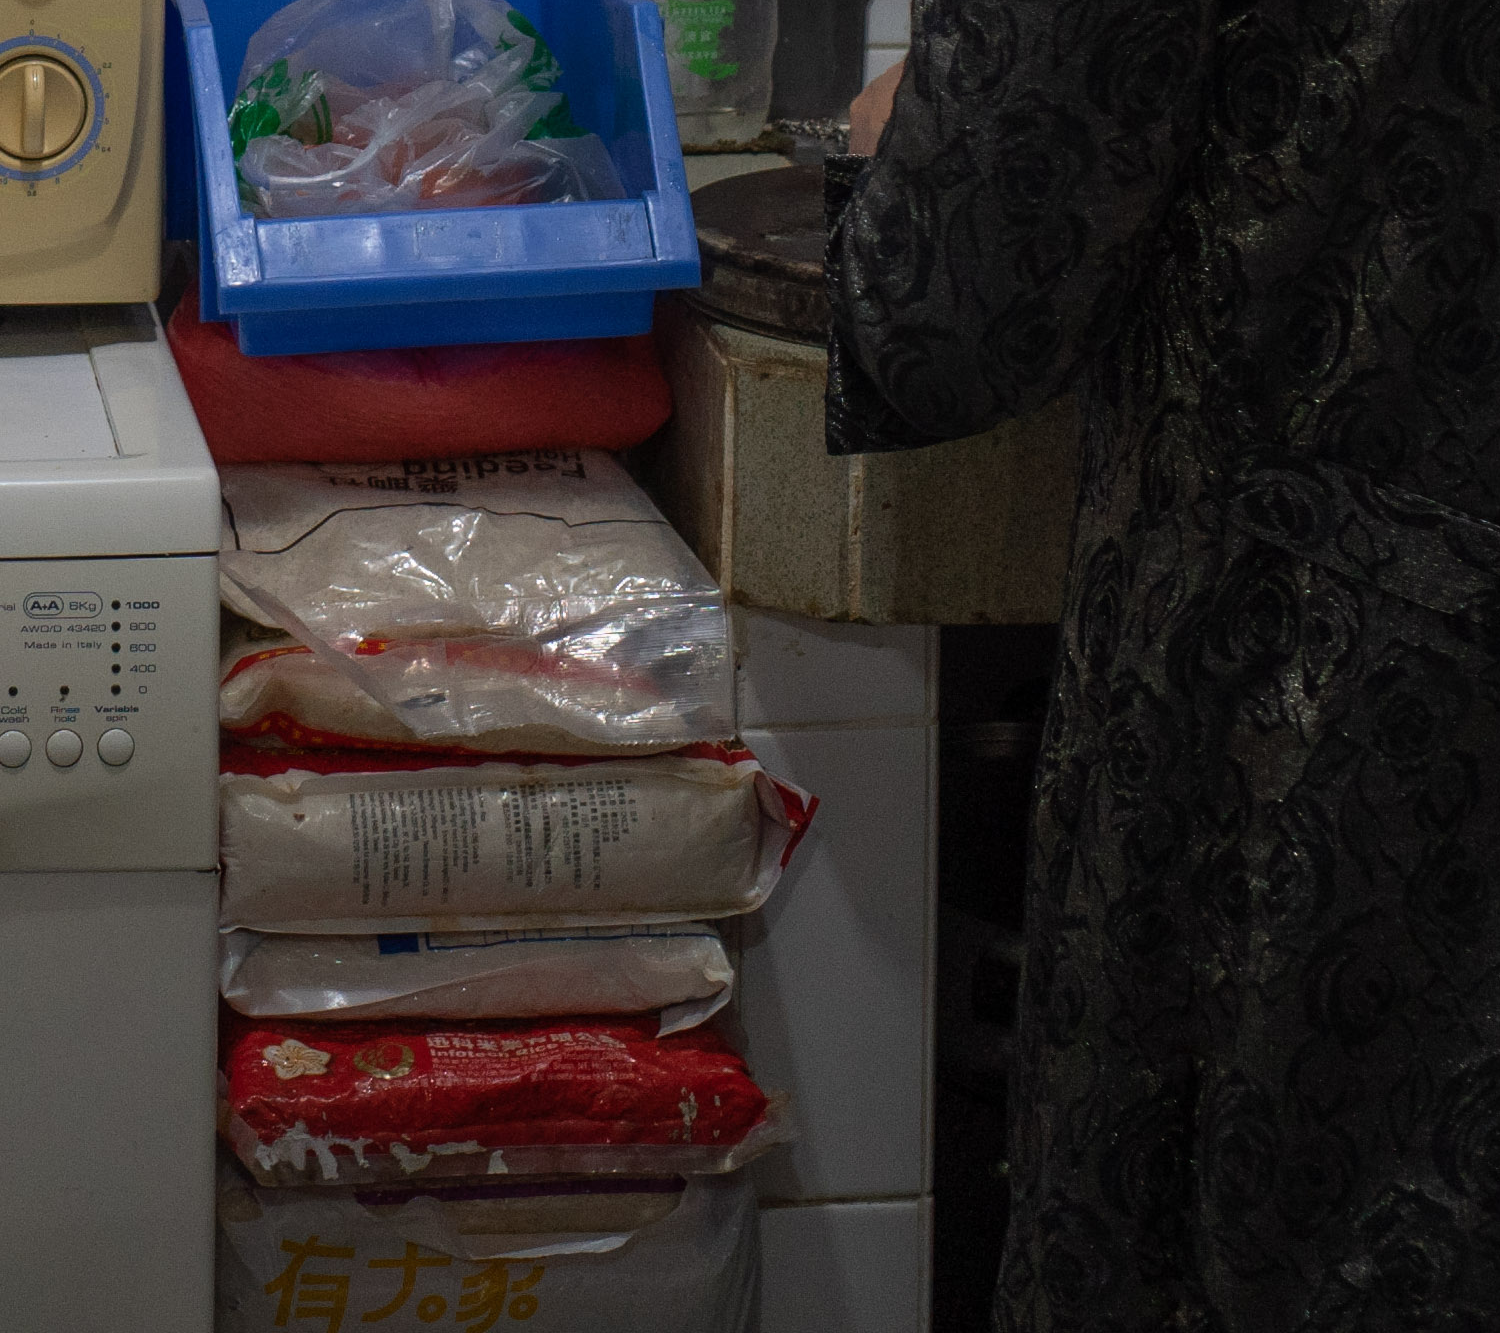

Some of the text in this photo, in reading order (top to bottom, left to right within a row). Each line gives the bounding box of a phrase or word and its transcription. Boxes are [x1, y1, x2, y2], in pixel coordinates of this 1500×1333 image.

[29, 600, 60, 611] A+A
[125, 601, 161, 610] 1000
[66, 623, 107, 633] 43420
[24, 641, 103, 651] Made in Italy
[129, 664, 157, 673] 400
[0, 706, 28, 715] Cold
[50, 706, 81, 714] Rinse
[94, 705, 139, 713] Variable
[0, 715, 30, 724] wash
[54, 714, 77, 723] hold
[105, 714, 127, 724] spin
